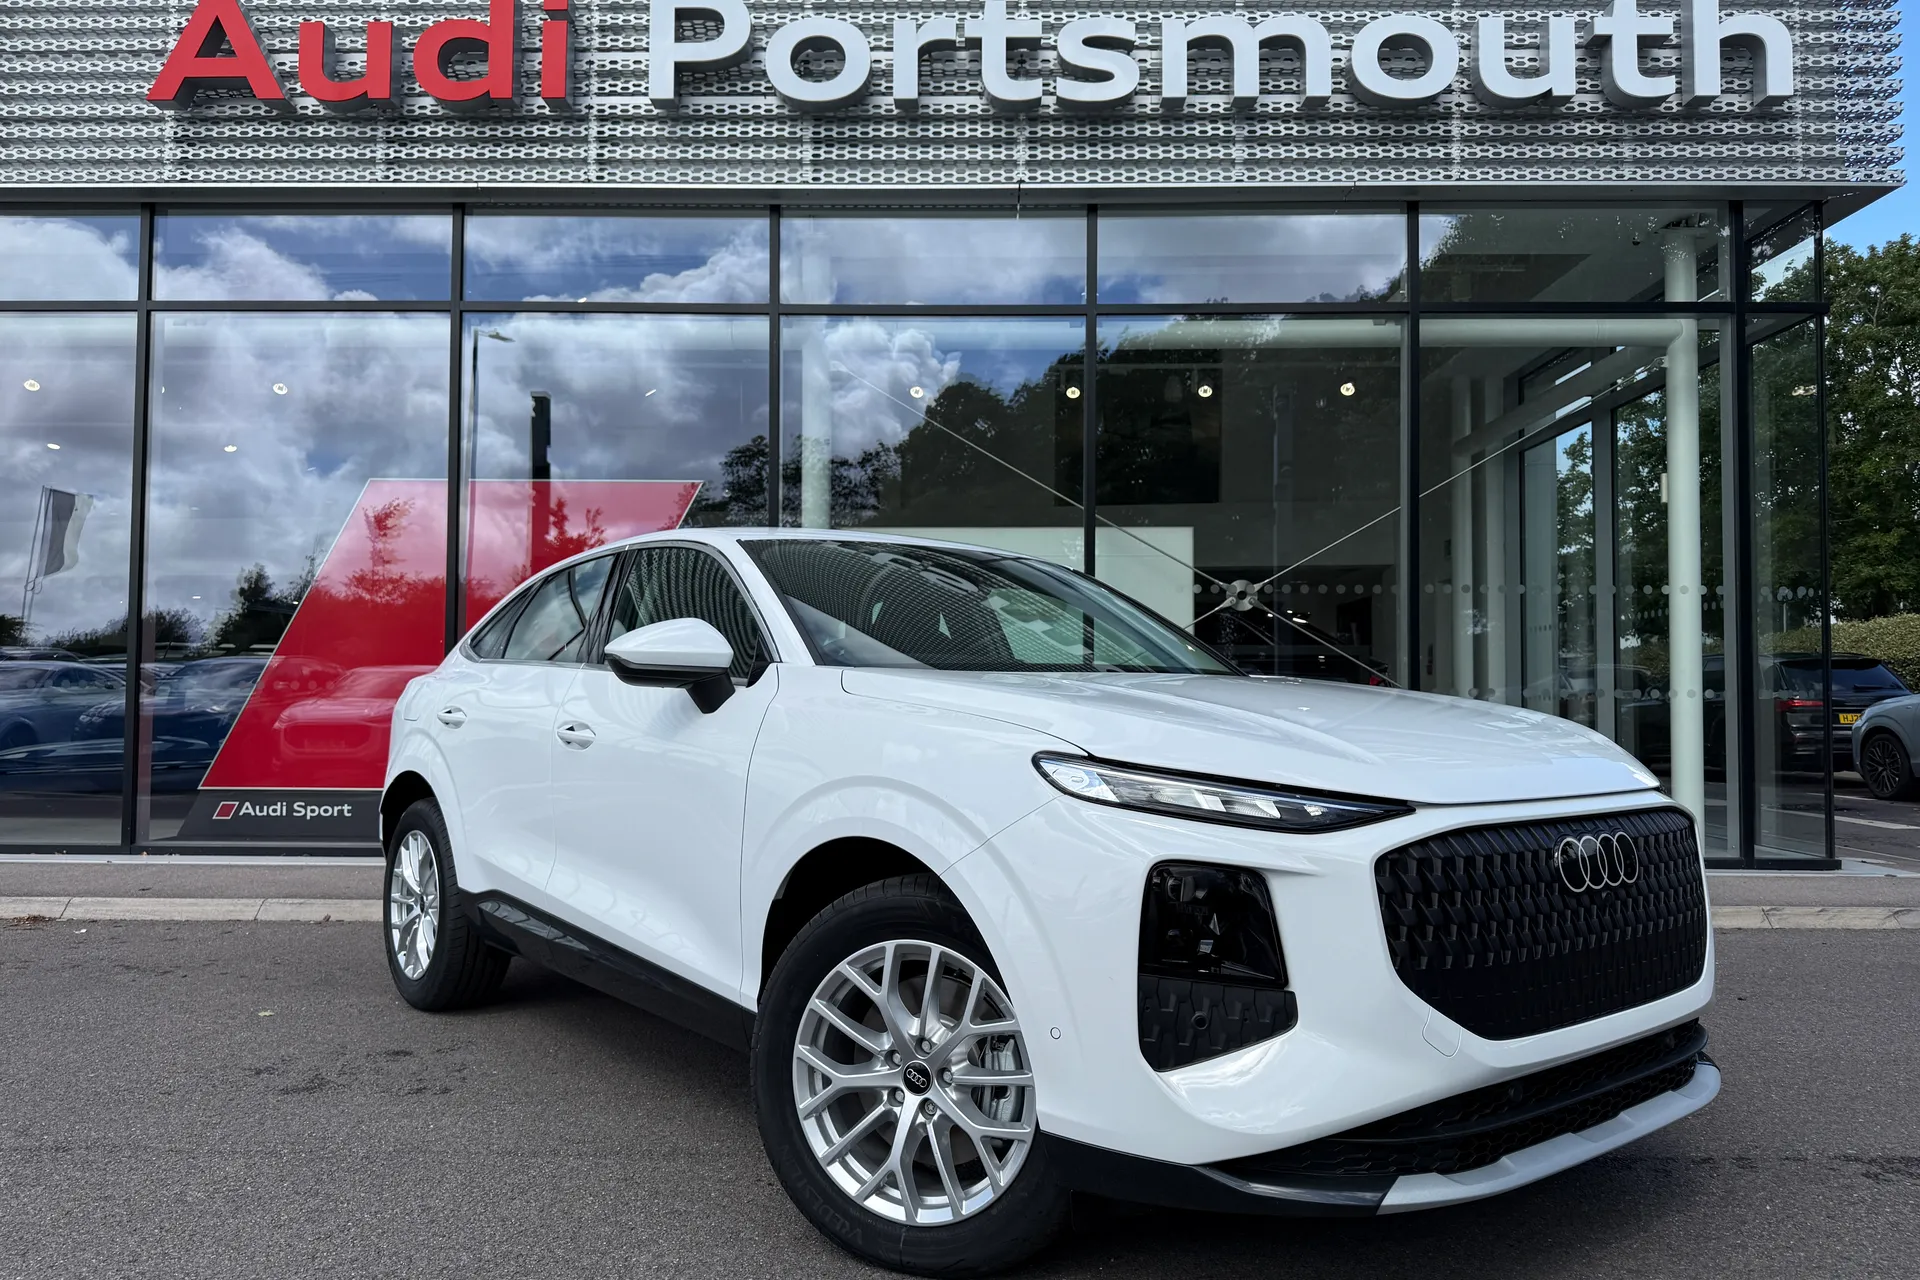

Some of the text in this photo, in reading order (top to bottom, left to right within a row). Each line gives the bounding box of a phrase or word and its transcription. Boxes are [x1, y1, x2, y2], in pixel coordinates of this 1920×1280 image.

[147, 0, 1795, 106] Audi Portsmouth
[238, 801, 353, 820] Audi Sport
